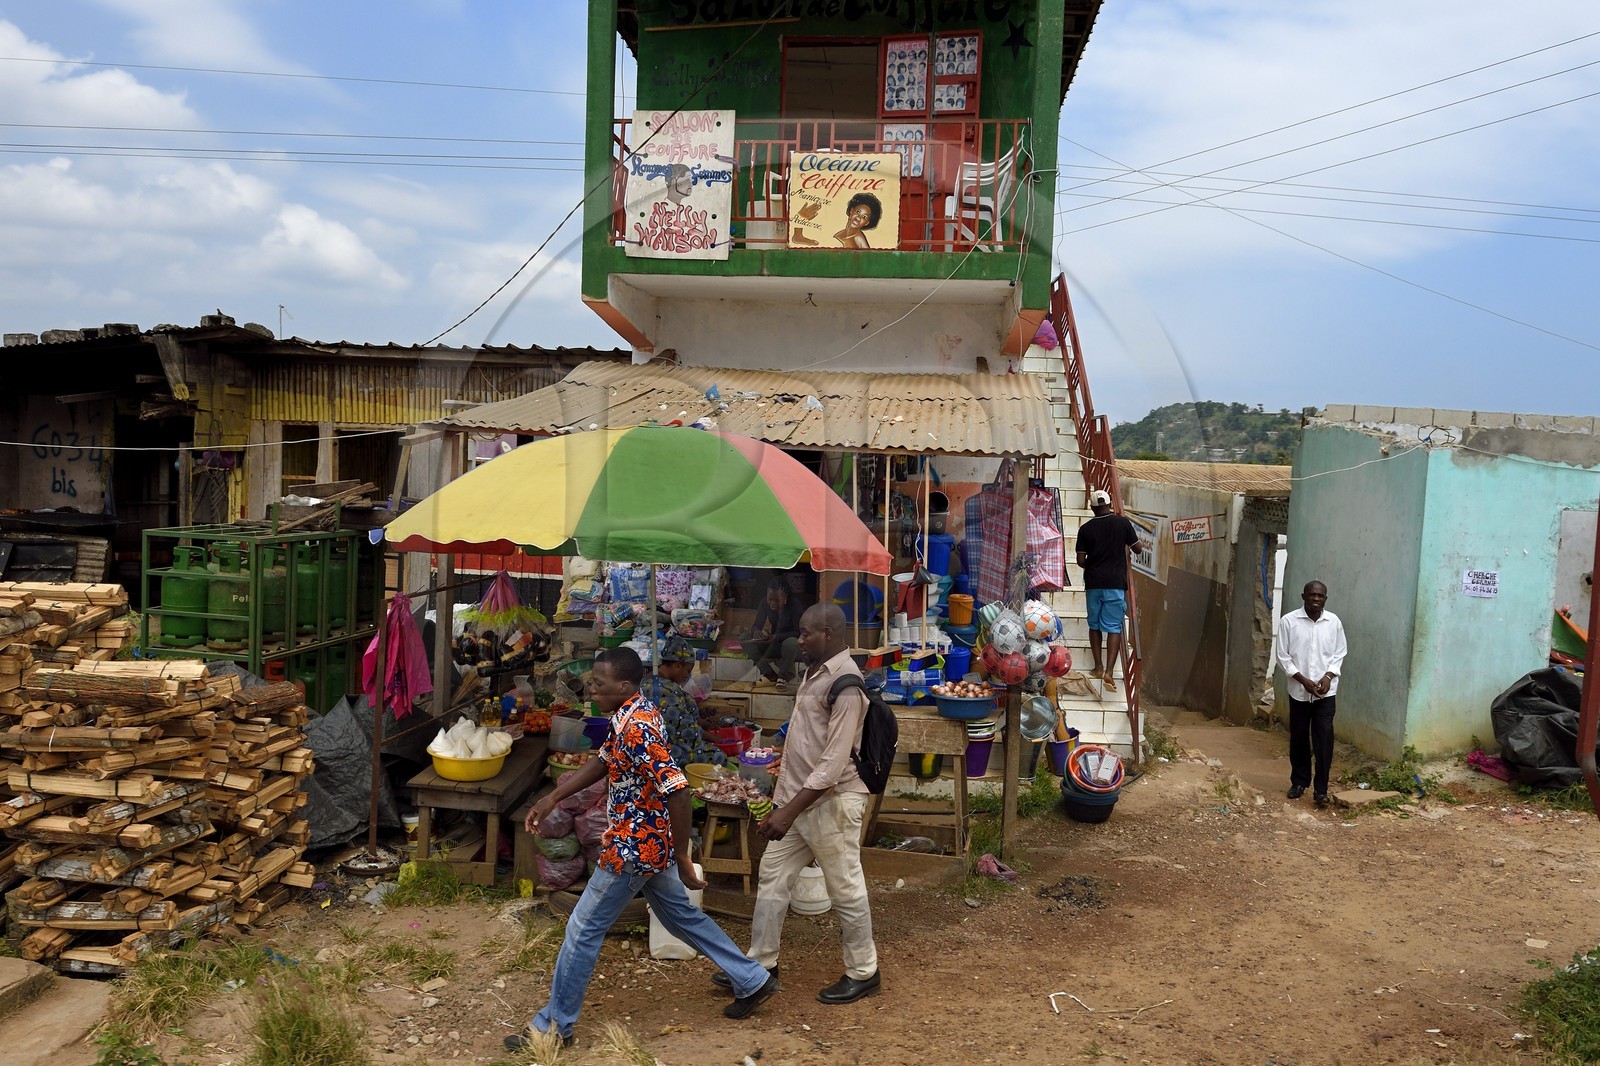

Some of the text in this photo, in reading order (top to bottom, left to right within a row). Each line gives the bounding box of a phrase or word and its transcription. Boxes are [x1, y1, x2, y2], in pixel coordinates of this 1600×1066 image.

[648, 111, 719, 136] SALON
[670, 132, 692, 144] DE
[644, 142, 718, 163] COIFFURE
[799, 153, 881, 173] Océane
[633, 222, 718, 254] WATSON
[51, 467, 77, 498] bis
[1174, 521, 1206, 533] Coiffure
[1468, 571, 1496, 580] CHERCHE
[232, 594, 250, 603] Pet
